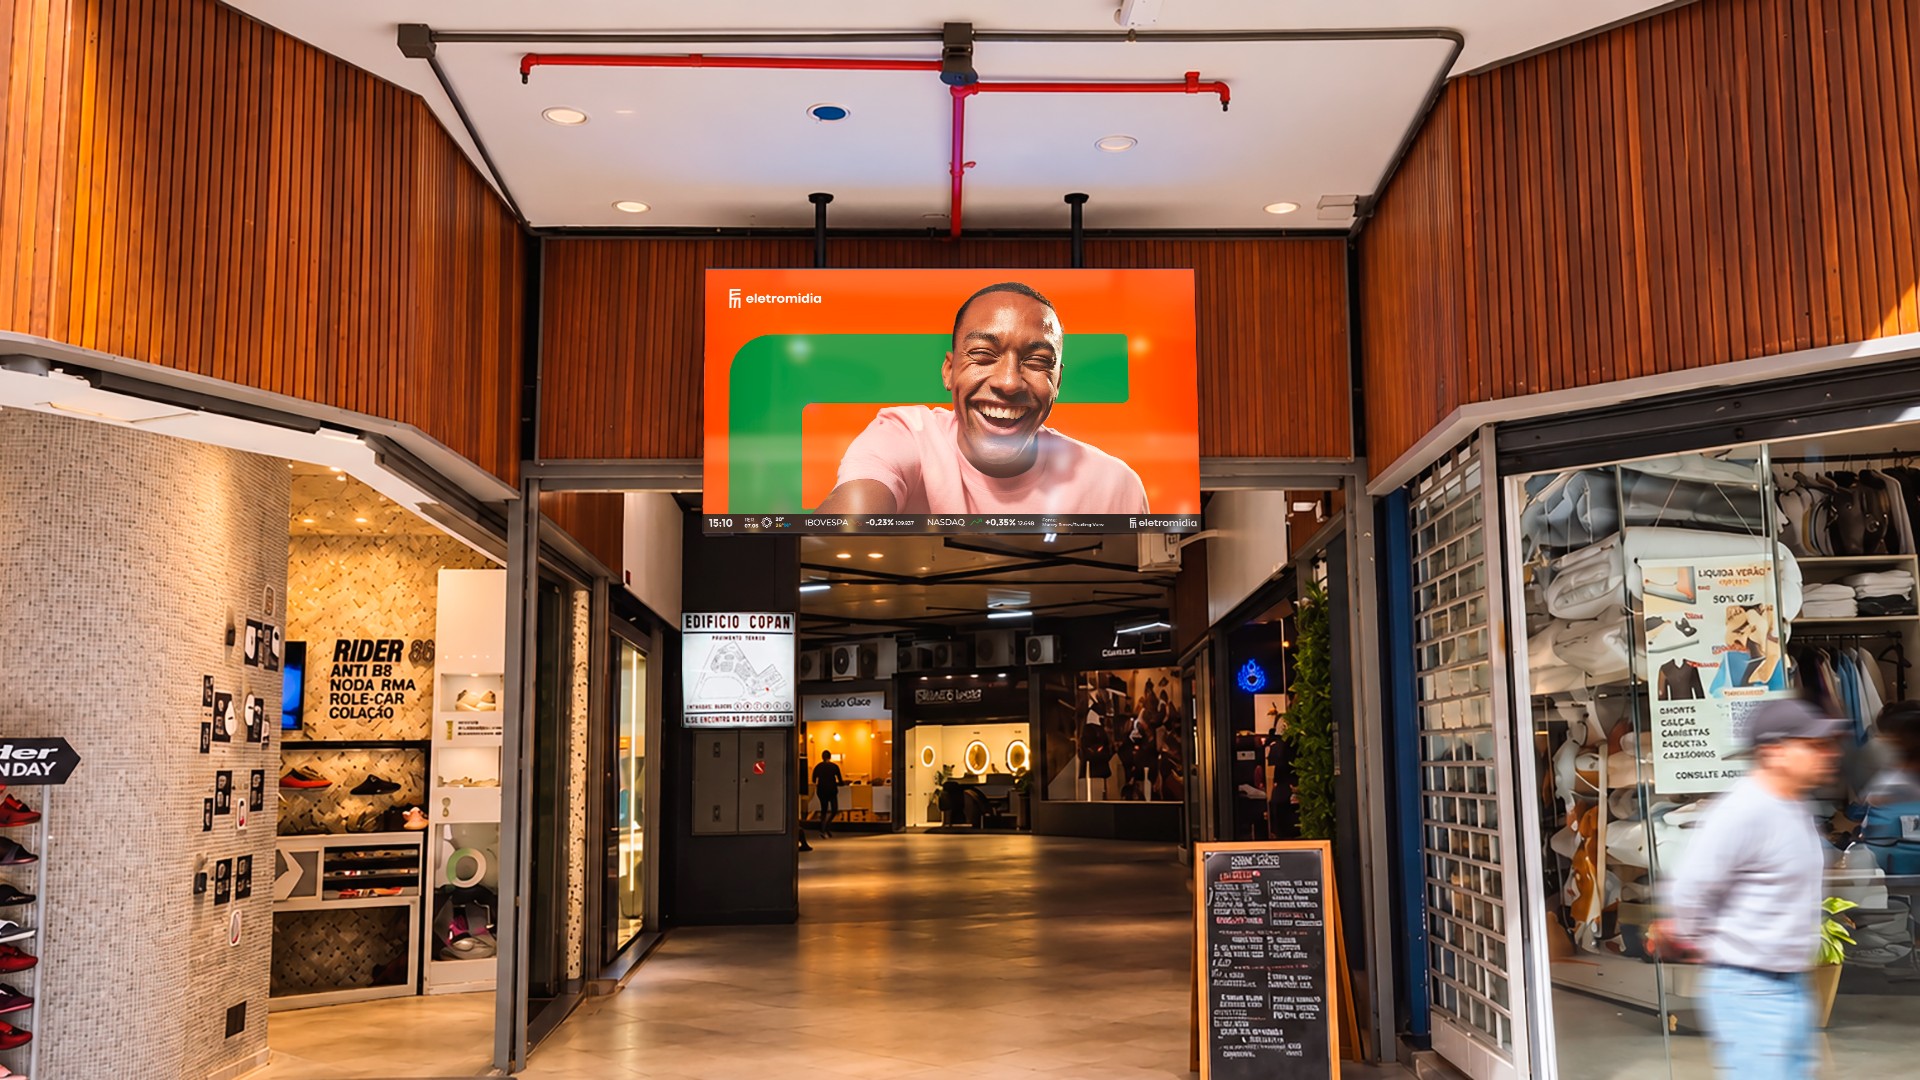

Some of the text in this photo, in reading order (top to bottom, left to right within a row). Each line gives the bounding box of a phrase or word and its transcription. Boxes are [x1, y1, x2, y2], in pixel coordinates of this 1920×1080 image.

[746, 293, 822, 304] eletromidia
[708, 518, 733, 528] 15:10
[805, 519, 849, 527] IBOVESPA
[865, 518, 894, 526] -0,23%
[927, 518, 966, 527] NASDAQ
[985, 518, 1016, 527] +0,35%
[1139, 518, 1198, 527] eletromidia
[1737, 594, 1755, 603] OFF
[685, 615, 791, 630] EDIFICIO COPAN
[333, 639, 404, 662] RIDER
[331, 664, 367, 677] ANTI
[330, 679, 416, 691] NODA RMA
